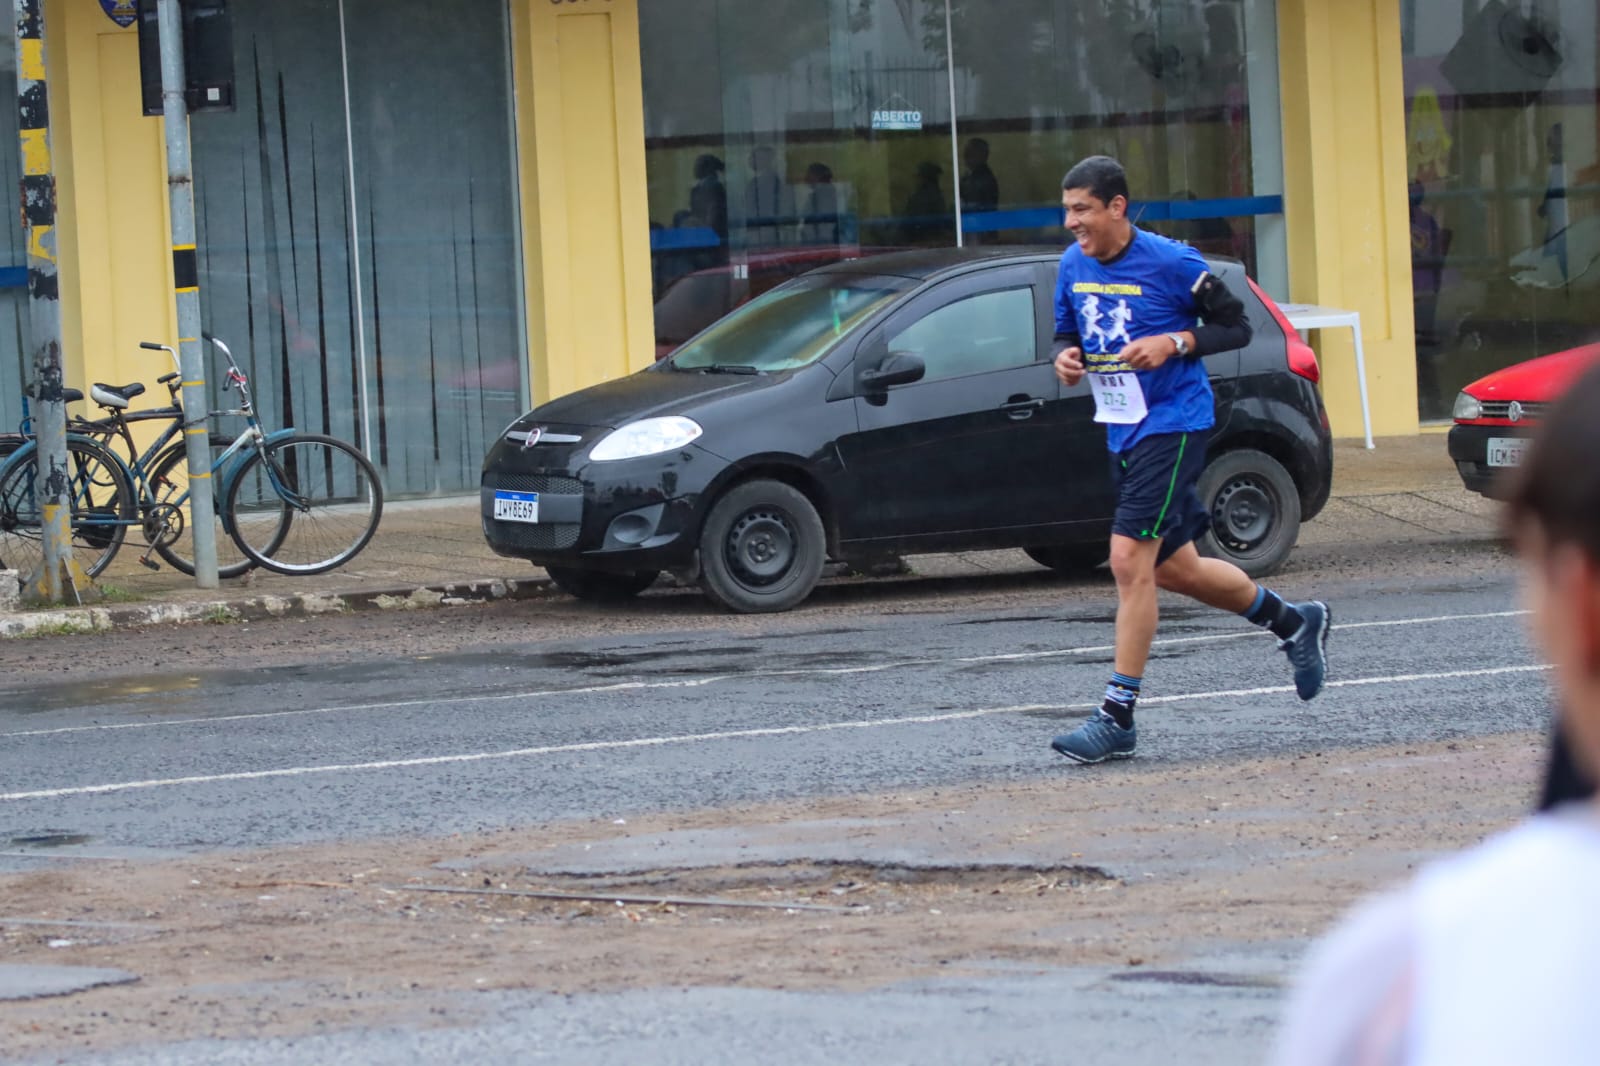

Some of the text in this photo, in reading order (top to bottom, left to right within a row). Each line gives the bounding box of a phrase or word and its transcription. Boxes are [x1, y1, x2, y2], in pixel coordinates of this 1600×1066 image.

[873, 110, 921, 122] ABERTO
[1101, 391, 1127, 406] 27-2
[497, 499, 533, 519] IWY8E69
